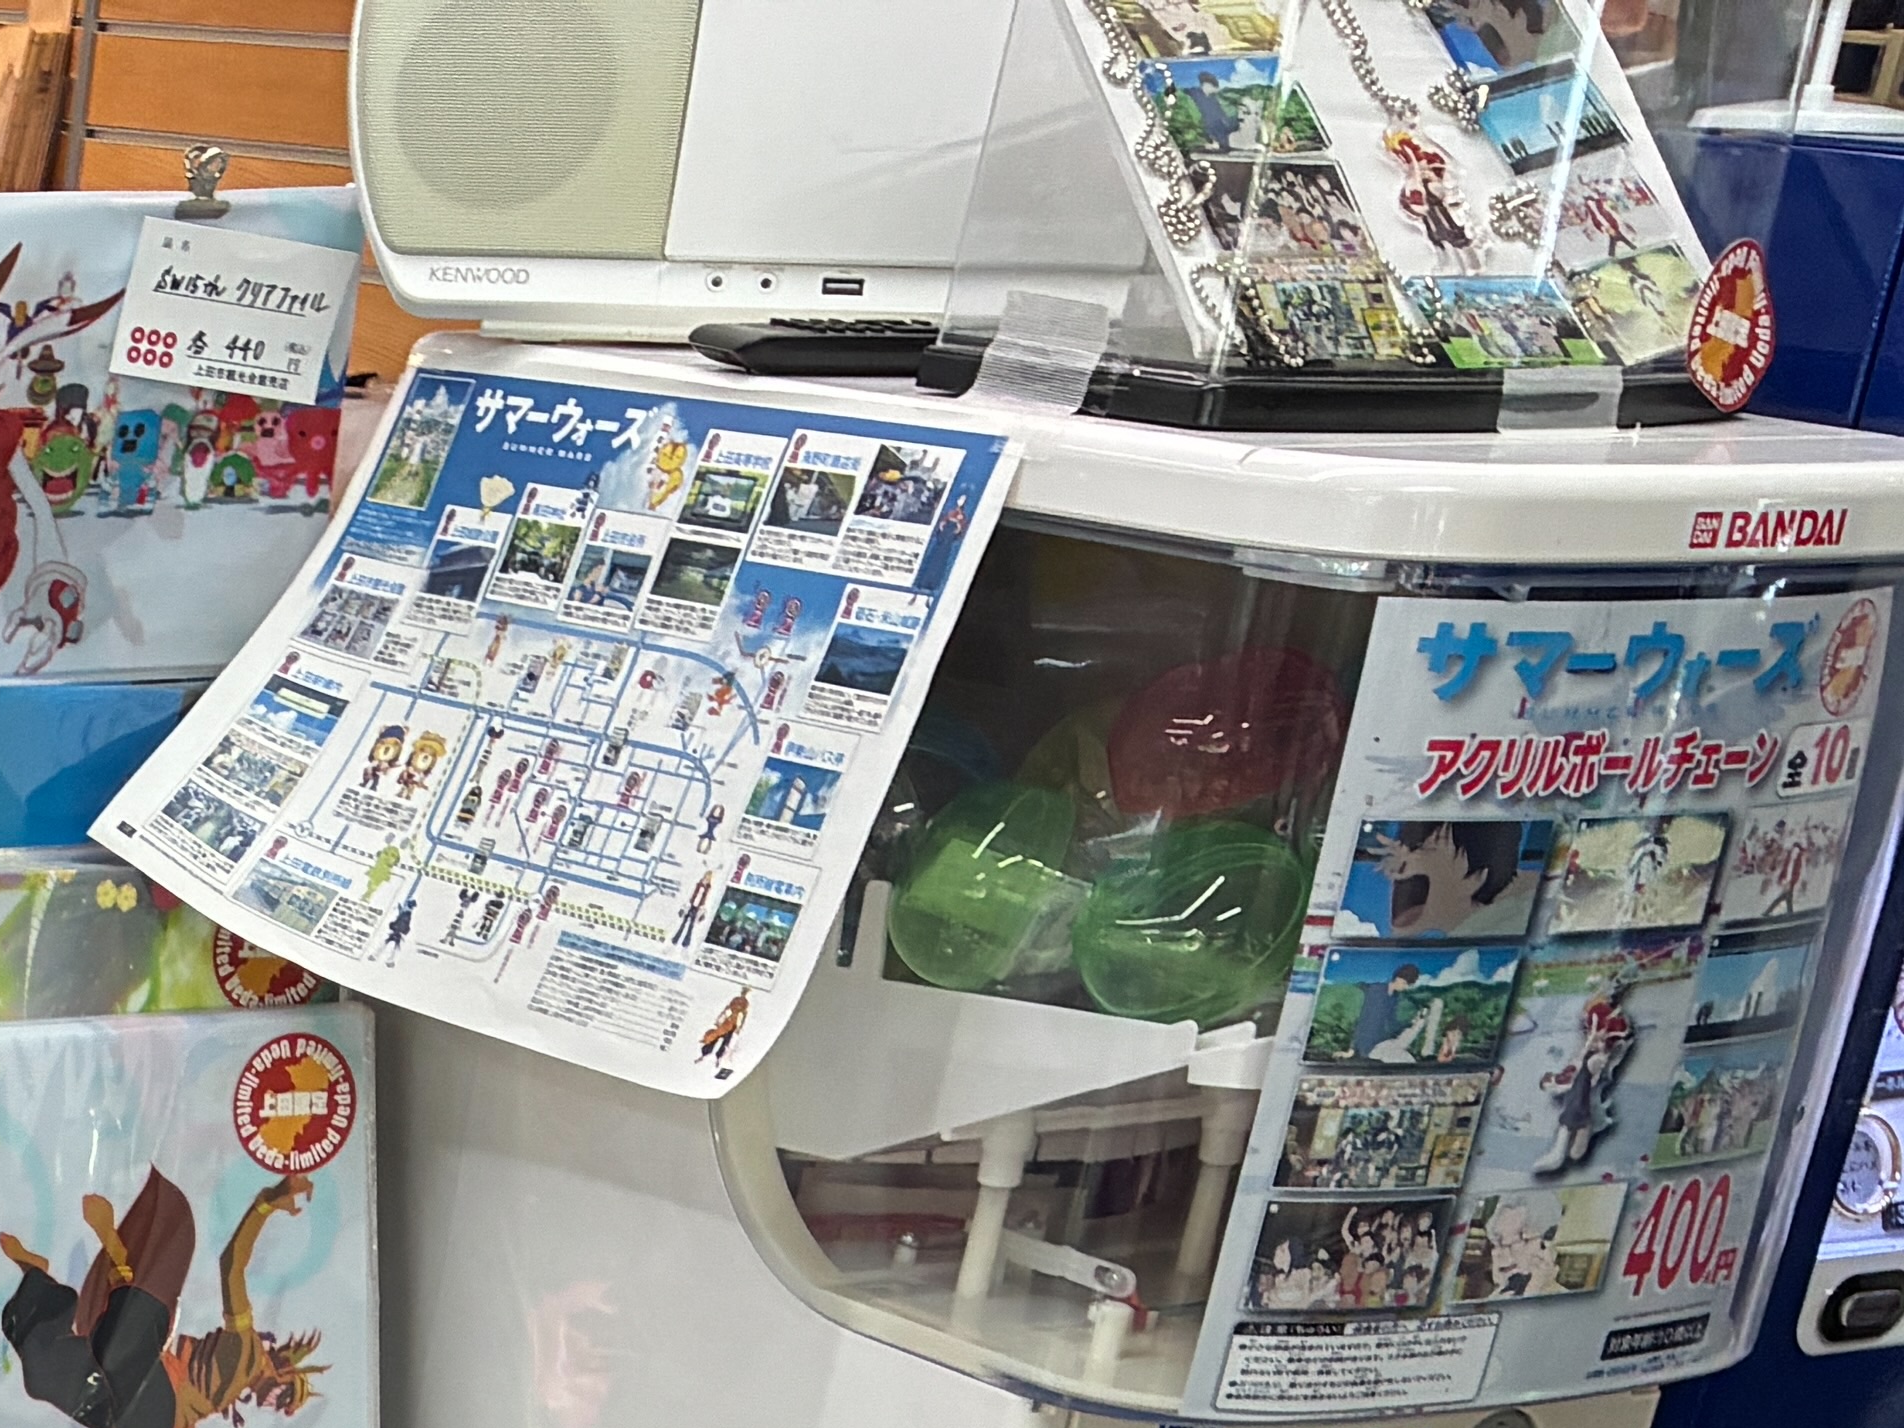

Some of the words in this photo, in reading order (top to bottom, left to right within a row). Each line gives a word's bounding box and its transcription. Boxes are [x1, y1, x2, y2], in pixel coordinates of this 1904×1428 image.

[428, 263, 531, 288] KENWOOD
[225, 335, 265, 361] 440
[476, 388, 660, 450] サマーウォーズ
[1725, 509, 1848, 548] BANDAI
[1417, 610, 1821, 702] サマーウォーズ
[1416, 729, 1780, 798] アクリルボールチェーン
